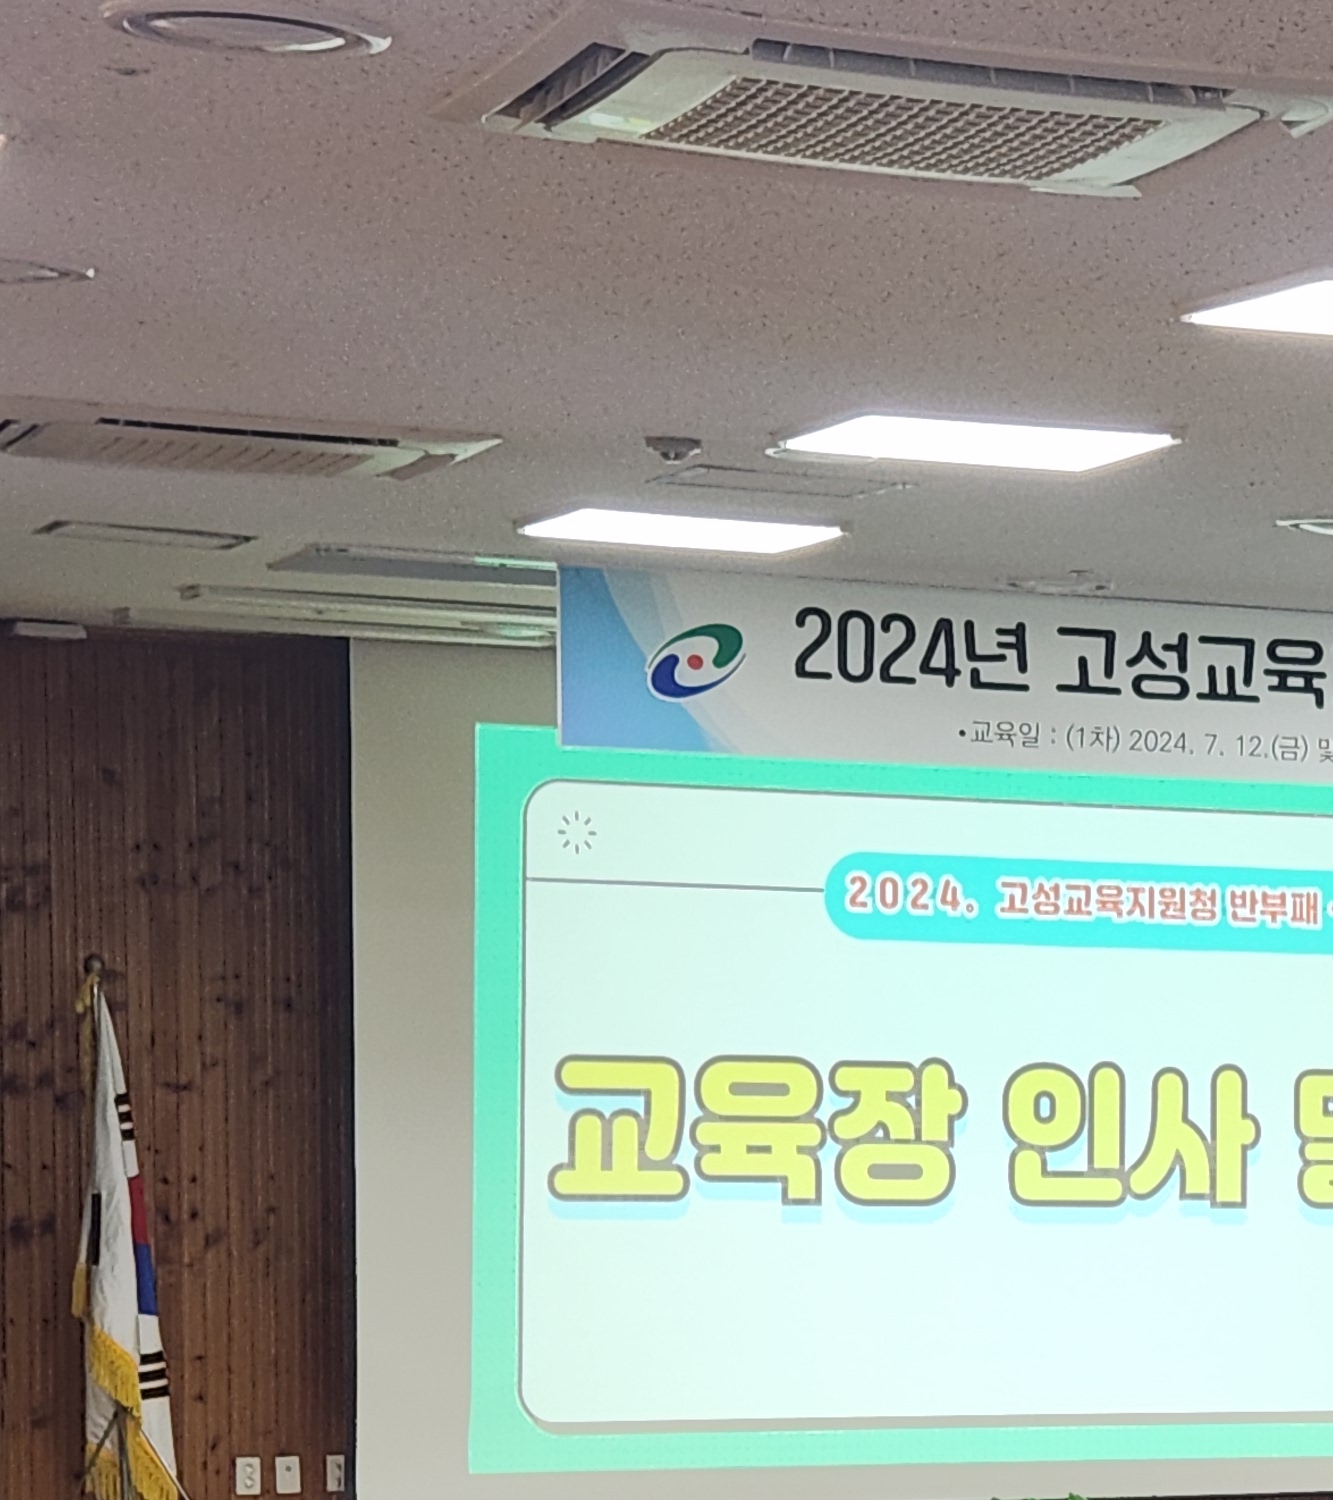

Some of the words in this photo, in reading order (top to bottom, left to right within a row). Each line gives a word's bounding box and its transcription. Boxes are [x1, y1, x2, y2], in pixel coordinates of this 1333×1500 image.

[794, 606, 1031, 693] 2024년
[970, 720, 1040, 749] 교육일
[1066, 723, 1120, 753] (1차)
[1129, 729, 1195, 756] 2024.
[1204, 732, 1225, 757] 7.
[847, 875, 976, 914] 2024.
[1000, 881, 1218, 921] 고성교육지원청
[547, 1052, 970, 1208] 교육장
[1005, 1062, 1260, 1210] 인사
